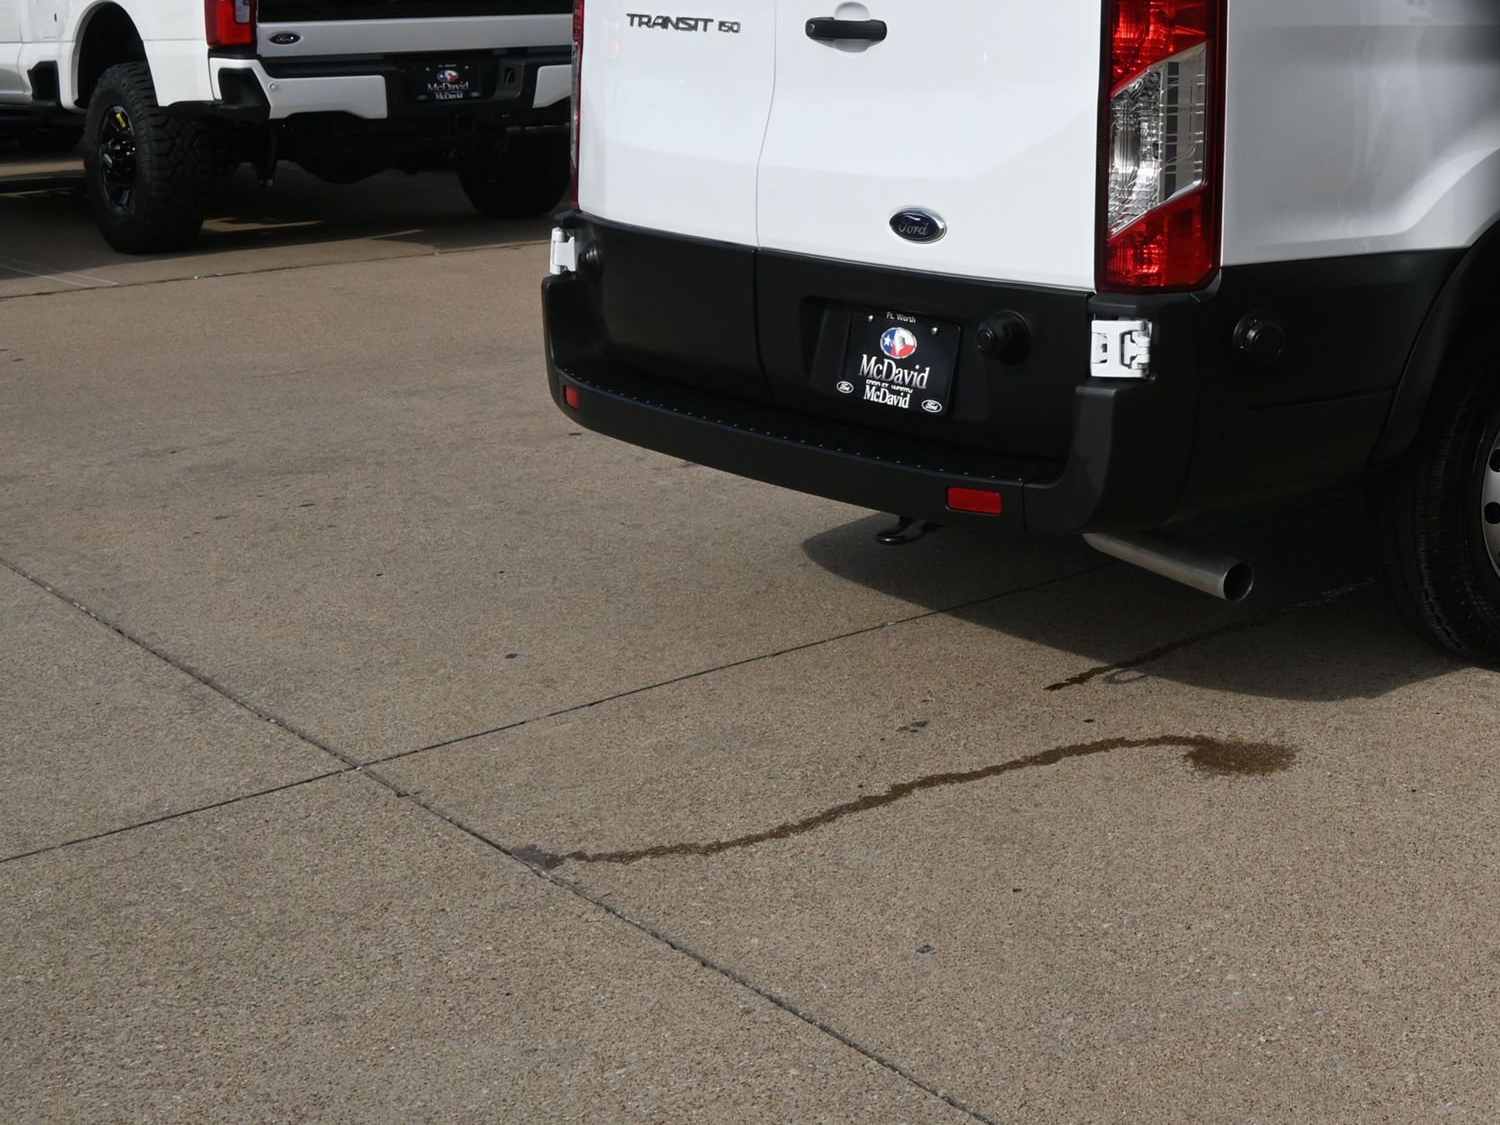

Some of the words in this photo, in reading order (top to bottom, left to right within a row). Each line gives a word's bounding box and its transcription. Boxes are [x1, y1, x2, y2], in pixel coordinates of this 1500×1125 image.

[626, 13, 714, 32] TRANSIT
[717, 20, 741, 33] 150
[427, 81, 469, 91] McDavid
[898, 215, 929, 236] Ford
[859, 354, 930, 389] McDavid
[863, 384, 911, 409] McDavid
